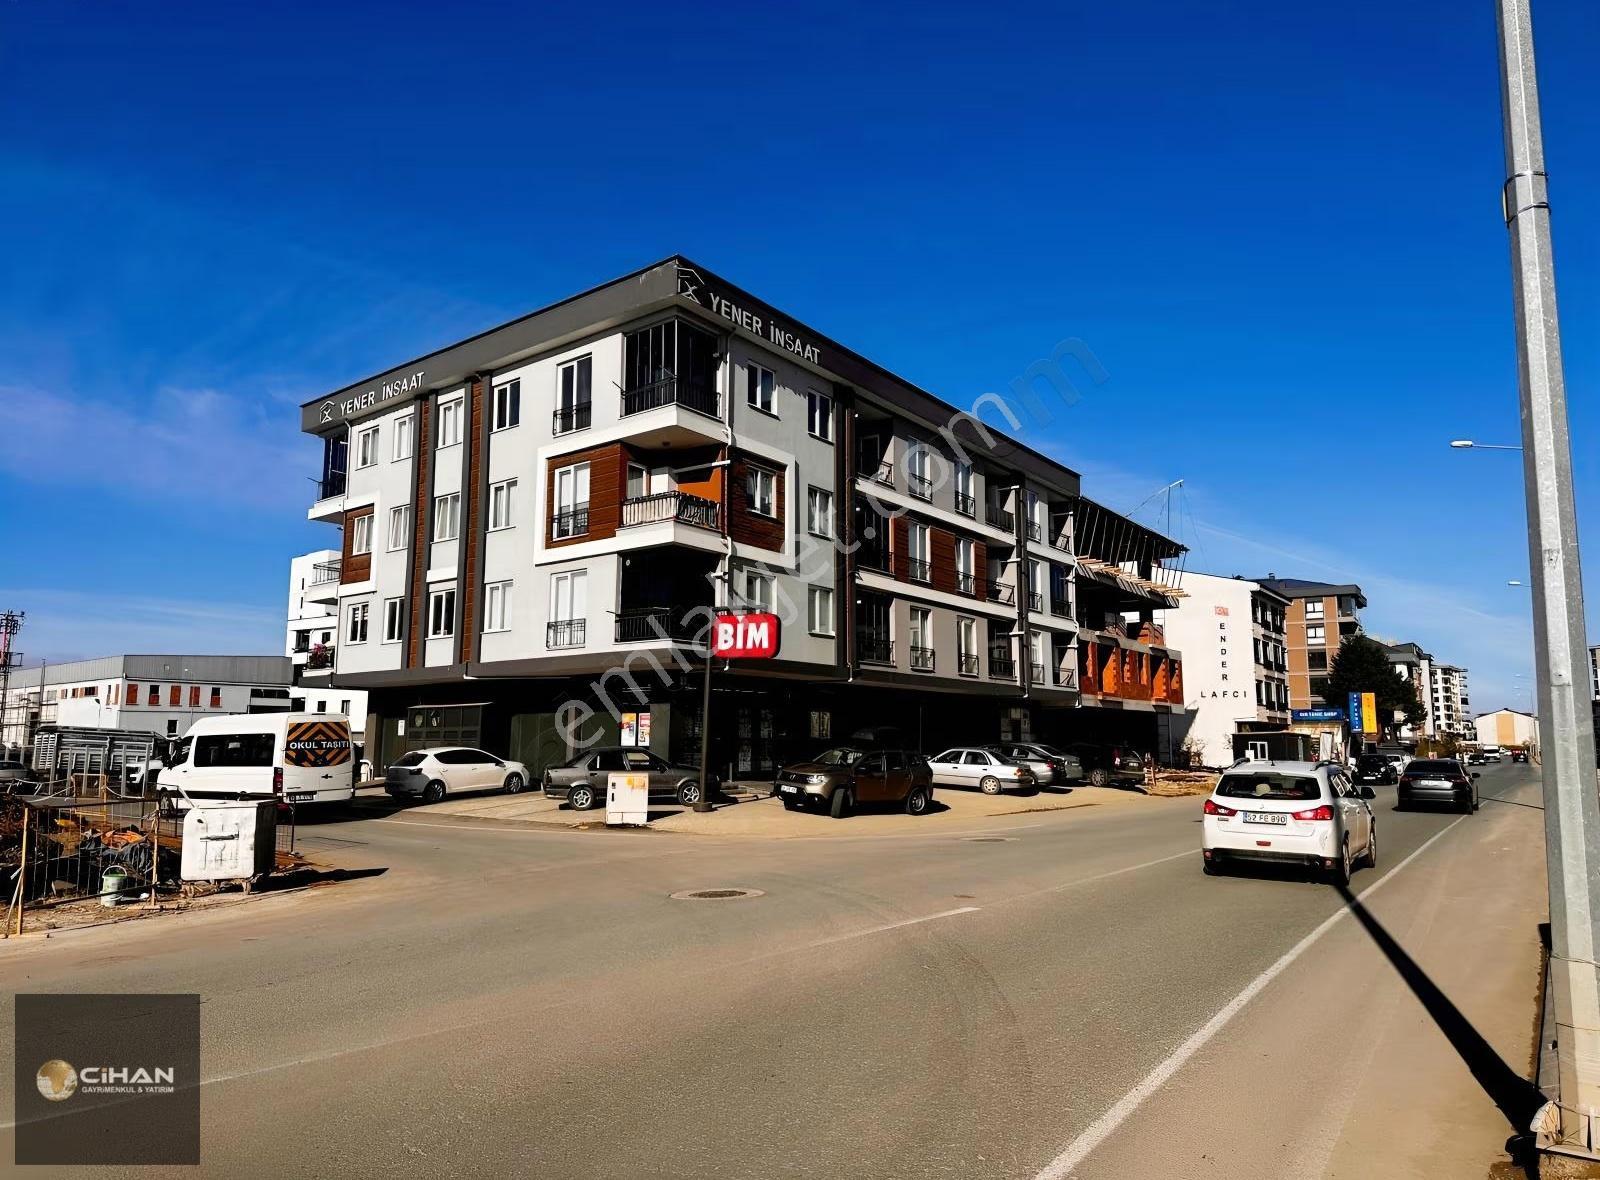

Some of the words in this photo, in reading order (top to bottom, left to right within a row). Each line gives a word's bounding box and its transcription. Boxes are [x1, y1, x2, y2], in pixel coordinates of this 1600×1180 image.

[709, 292, 762, 336] YENER
[340, 391, 375, 416] YENER
[1219, 622, 1228, 681] ENDER
[1200, 690, 1247, 698] LAFCI
[289, 741, 318, 749] OKUL
